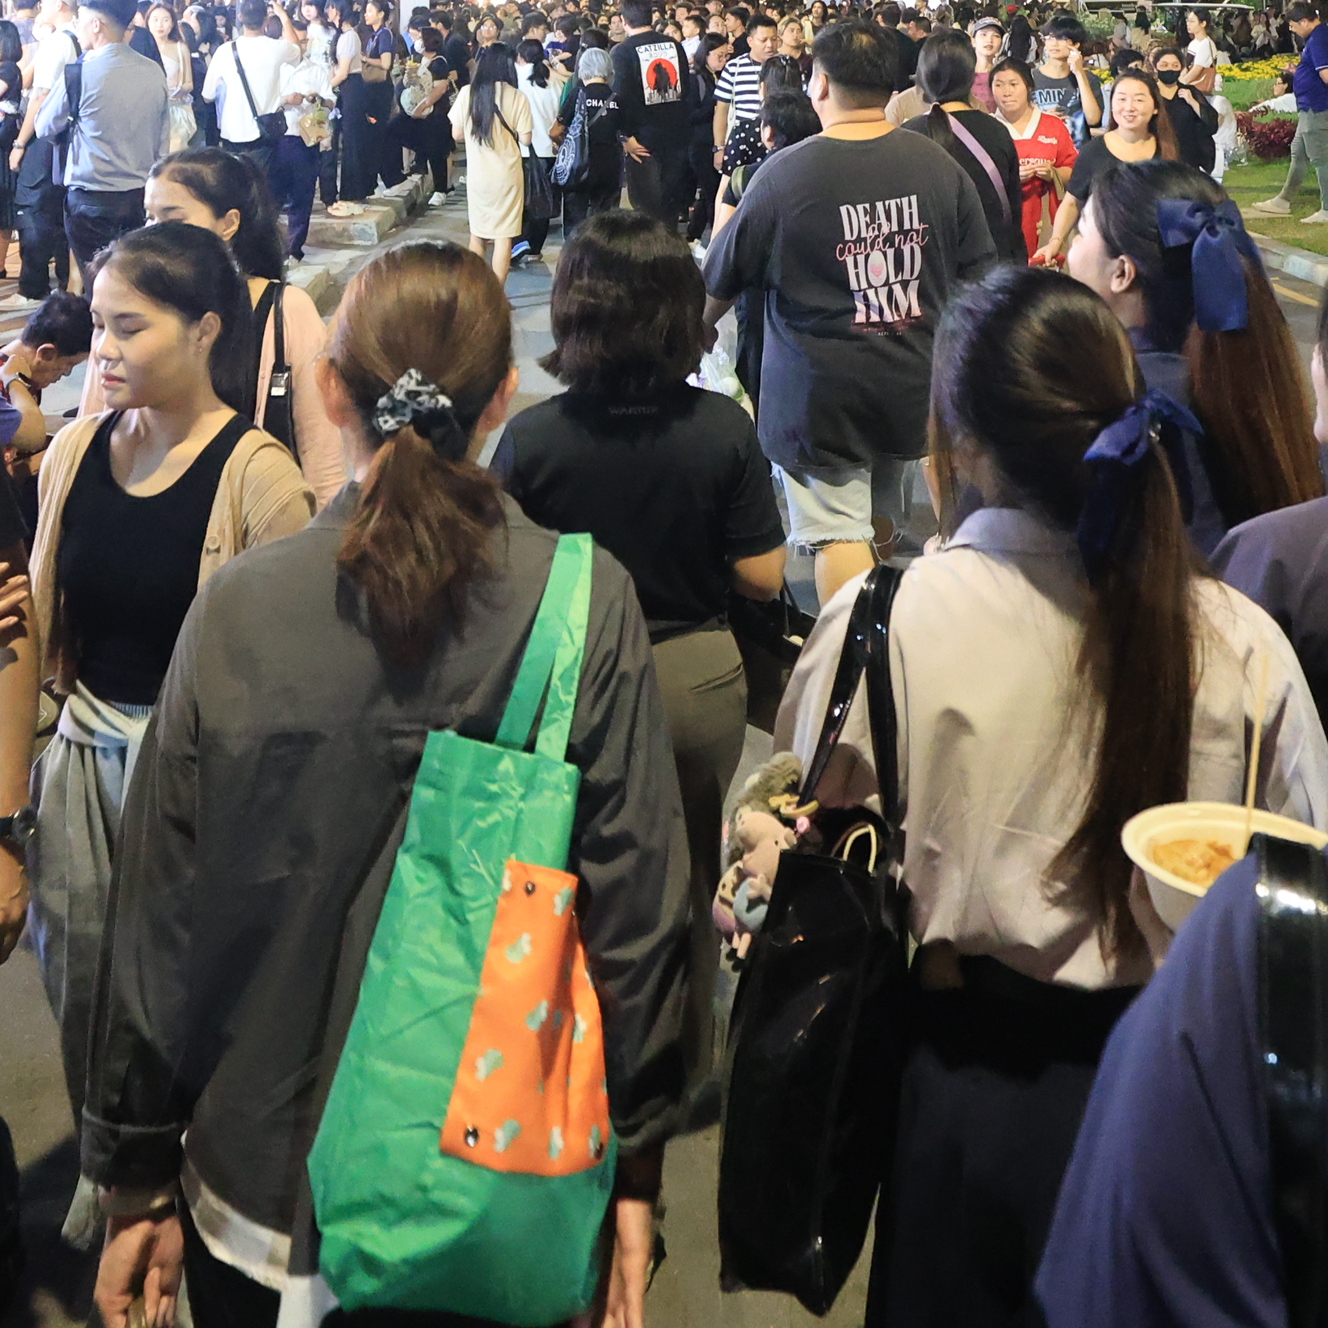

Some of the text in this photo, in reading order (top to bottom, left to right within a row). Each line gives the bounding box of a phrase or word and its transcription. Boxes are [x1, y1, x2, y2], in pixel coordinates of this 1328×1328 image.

[637, 43, 675, 54] CATZILLA
[839, 194, 920, 241] DEATH
[836, 222, 930, 261] could not
[845, 243, 922, 291] HOLD
[852, 279, 923, 324] HIM
